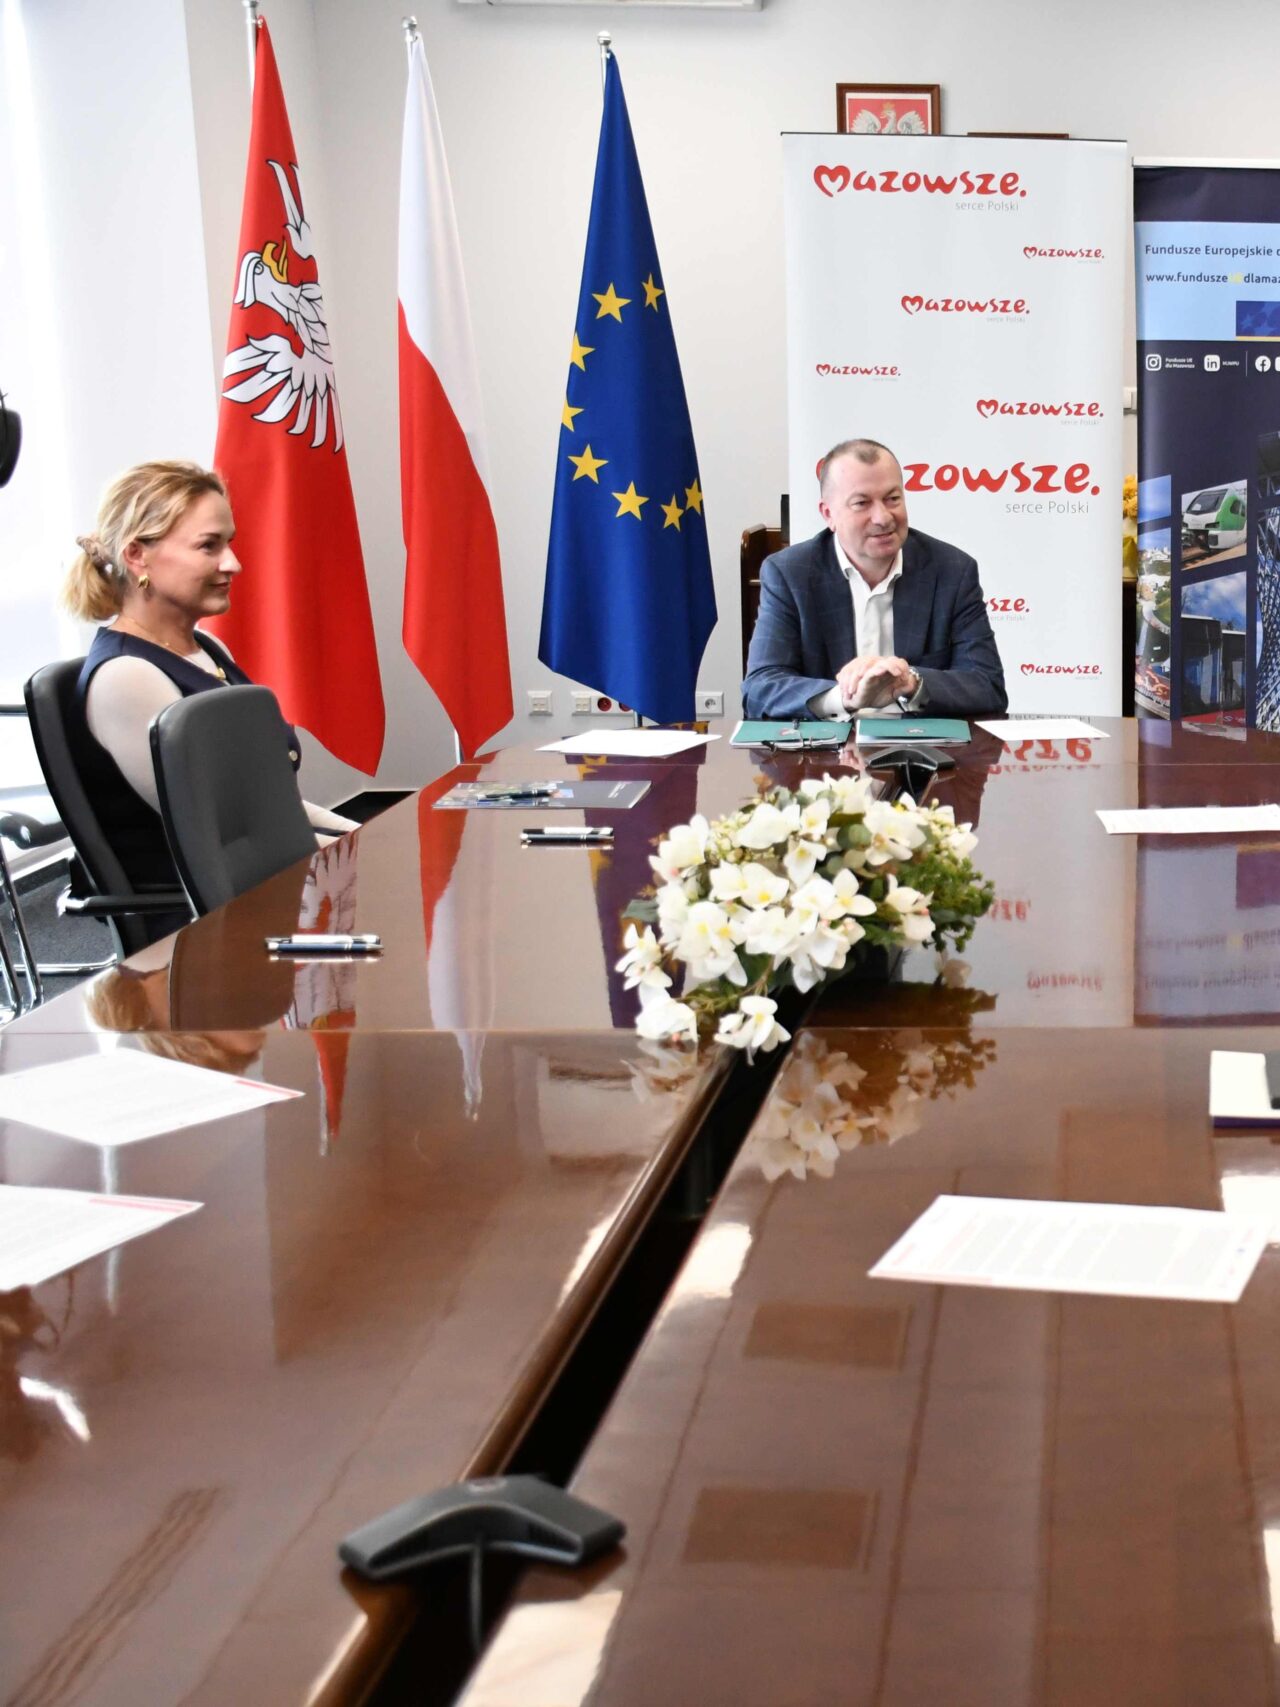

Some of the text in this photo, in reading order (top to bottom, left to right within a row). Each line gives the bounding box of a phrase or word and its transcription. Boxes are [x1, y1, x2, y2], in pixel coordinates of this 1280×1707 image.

[955, 200, 1019, 212] serce Polski
[1145, 244, 1200, 255] Fundusze
[1204, 245, 1273, 258] Europejskie
[816, 458, 1100, 496] zowsze.
[1005, 500, 1089, 514] serce Polski
